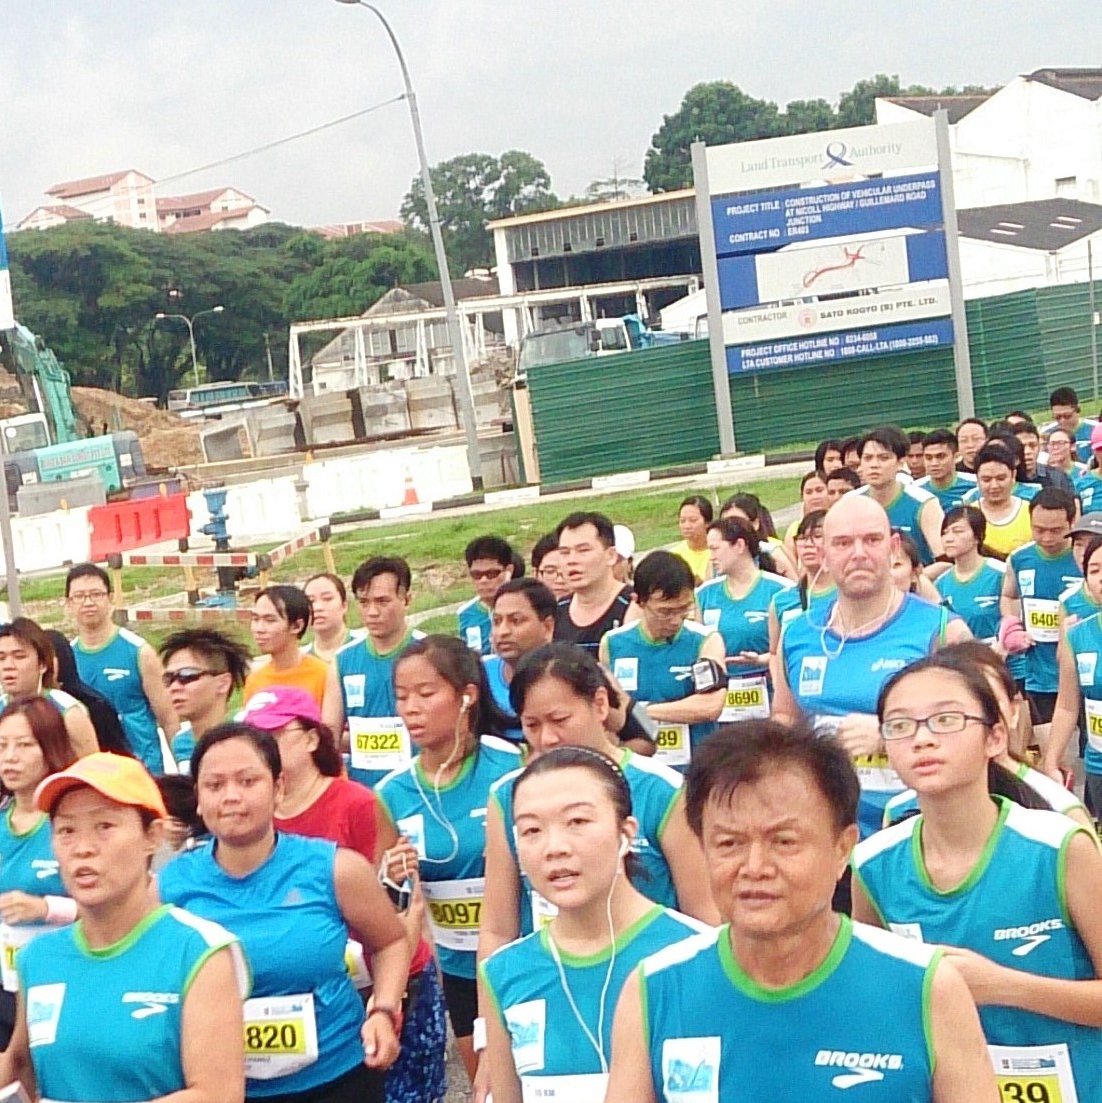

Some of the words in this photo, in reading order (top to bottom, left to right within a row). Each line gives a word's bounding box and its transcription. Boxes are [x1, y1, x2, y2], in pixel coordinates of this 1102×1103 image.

[741, 158, 768, 173] Land
[771, 152, 823, 169] Transport
[849, 141, 903, 160] Authority
[726, 203, 759, 216] PROJECT
[760, 200, 780, 212] TITLE
[785, 193, 840, 208] CONSTRUCTION
[841, 191, 851, 201] OF
[852, 185, 892, 199] VEHICULAR
[893, 179, 936, 194] UNDERPASS
[785, 208, 794, 218] AT
[822, 200, 854, 213] HIGHWAY
[906, 190, 927, 203] ROAD
[785, 214, 822, 226] JUNCTION
[729, 230, 768, 243] CONTRACT
[768, 228, 781, 239] NO
[738, 311, 787, 325] CONTRACTOR
[819, 310, 844, 319] SATO
[846, 304, 878, 316] KOGYO
[741, 344, 773, 358] PROJECT
[773, 341, 798, 354] OFFICE
[798, 338, 827, 350] HOTLINE
[828, 336, 840, 347] NO
[742, 358, 755, 370] LTA
[755, 353, 793, 367] CUSTOMER
[794, 349, 824, 362] HOTLINE
[824, 347, 835, 359] NO
[993, 918, 1063, 941] BROOKS
[814, 1050, 902, 1070] BROOKS
